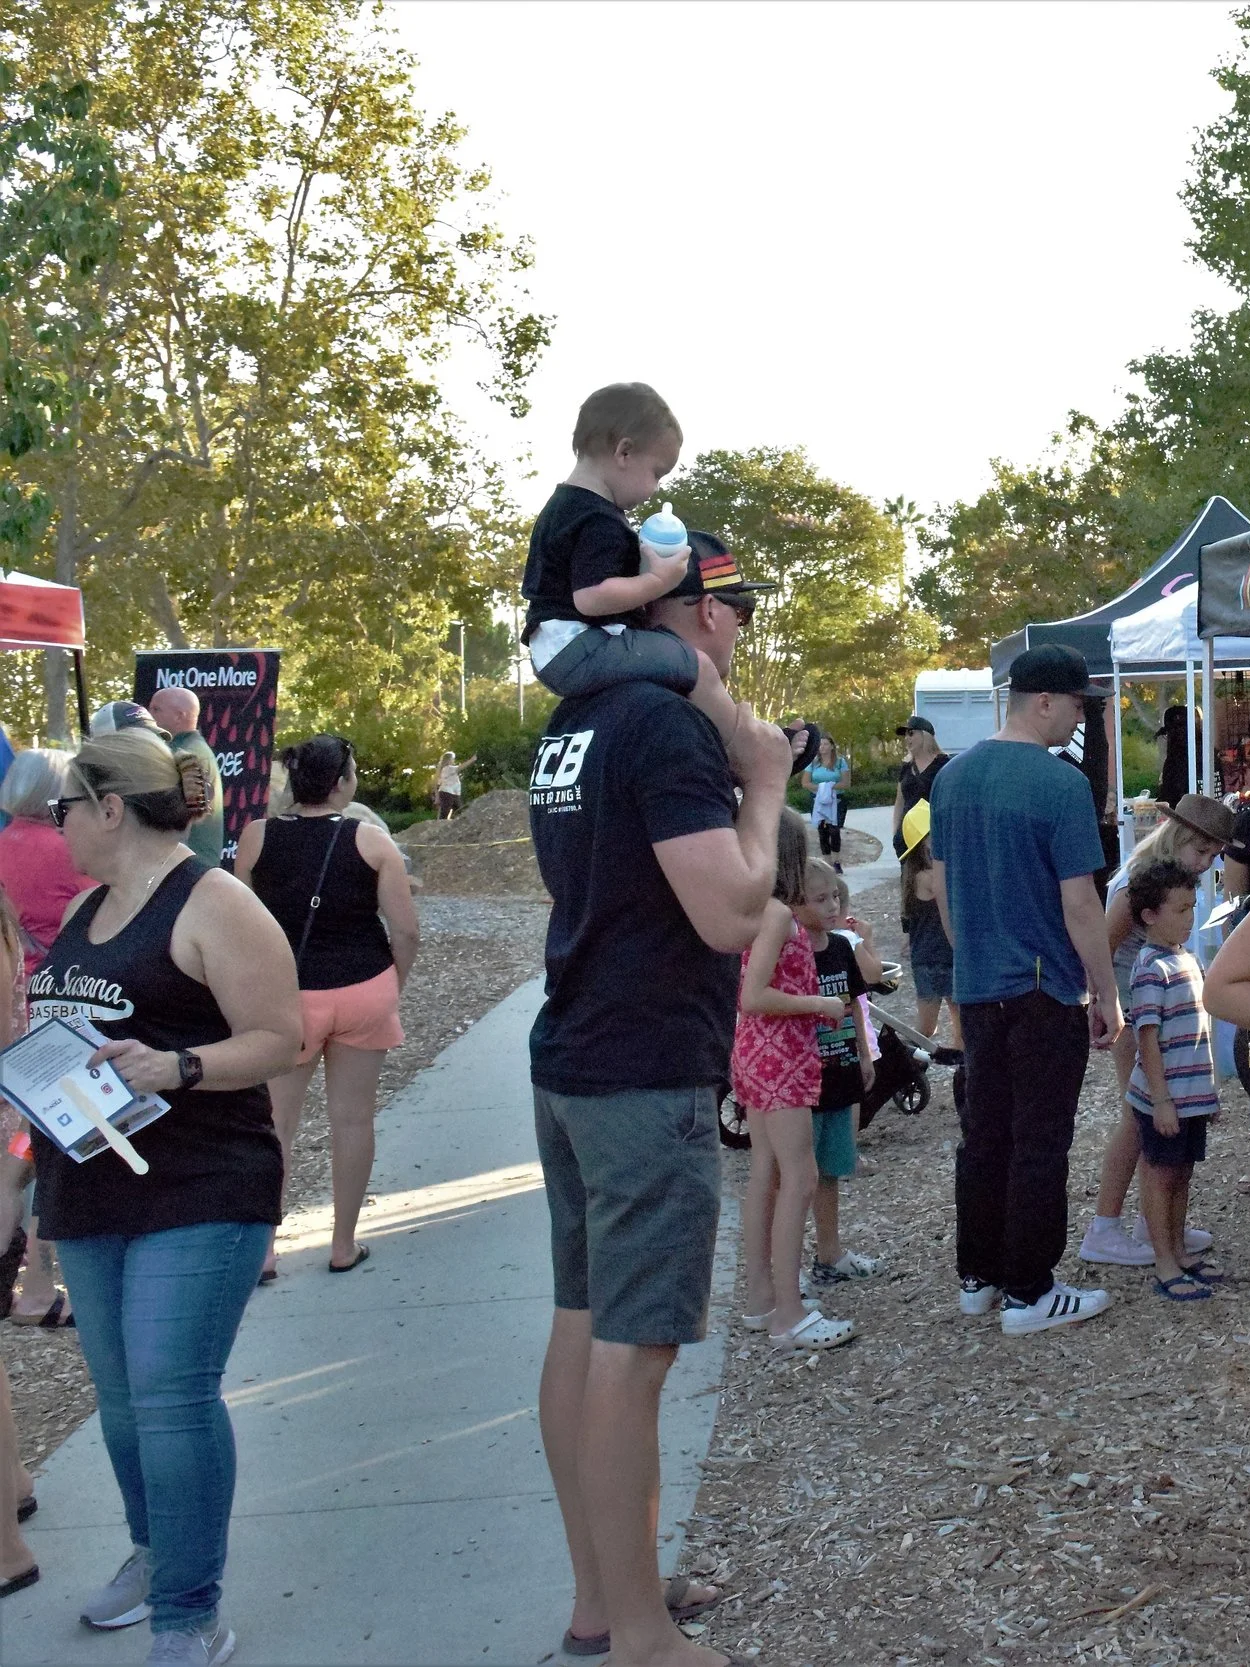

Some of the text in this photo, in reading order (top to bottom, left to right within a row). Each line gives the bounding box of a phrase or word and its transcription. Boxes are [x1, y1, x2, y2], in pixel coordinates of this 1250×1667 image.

[156, 666, 257, 688] Not One More
[530, 730, 594, 790] CB
[55, 965, 122, 1004] Susana
